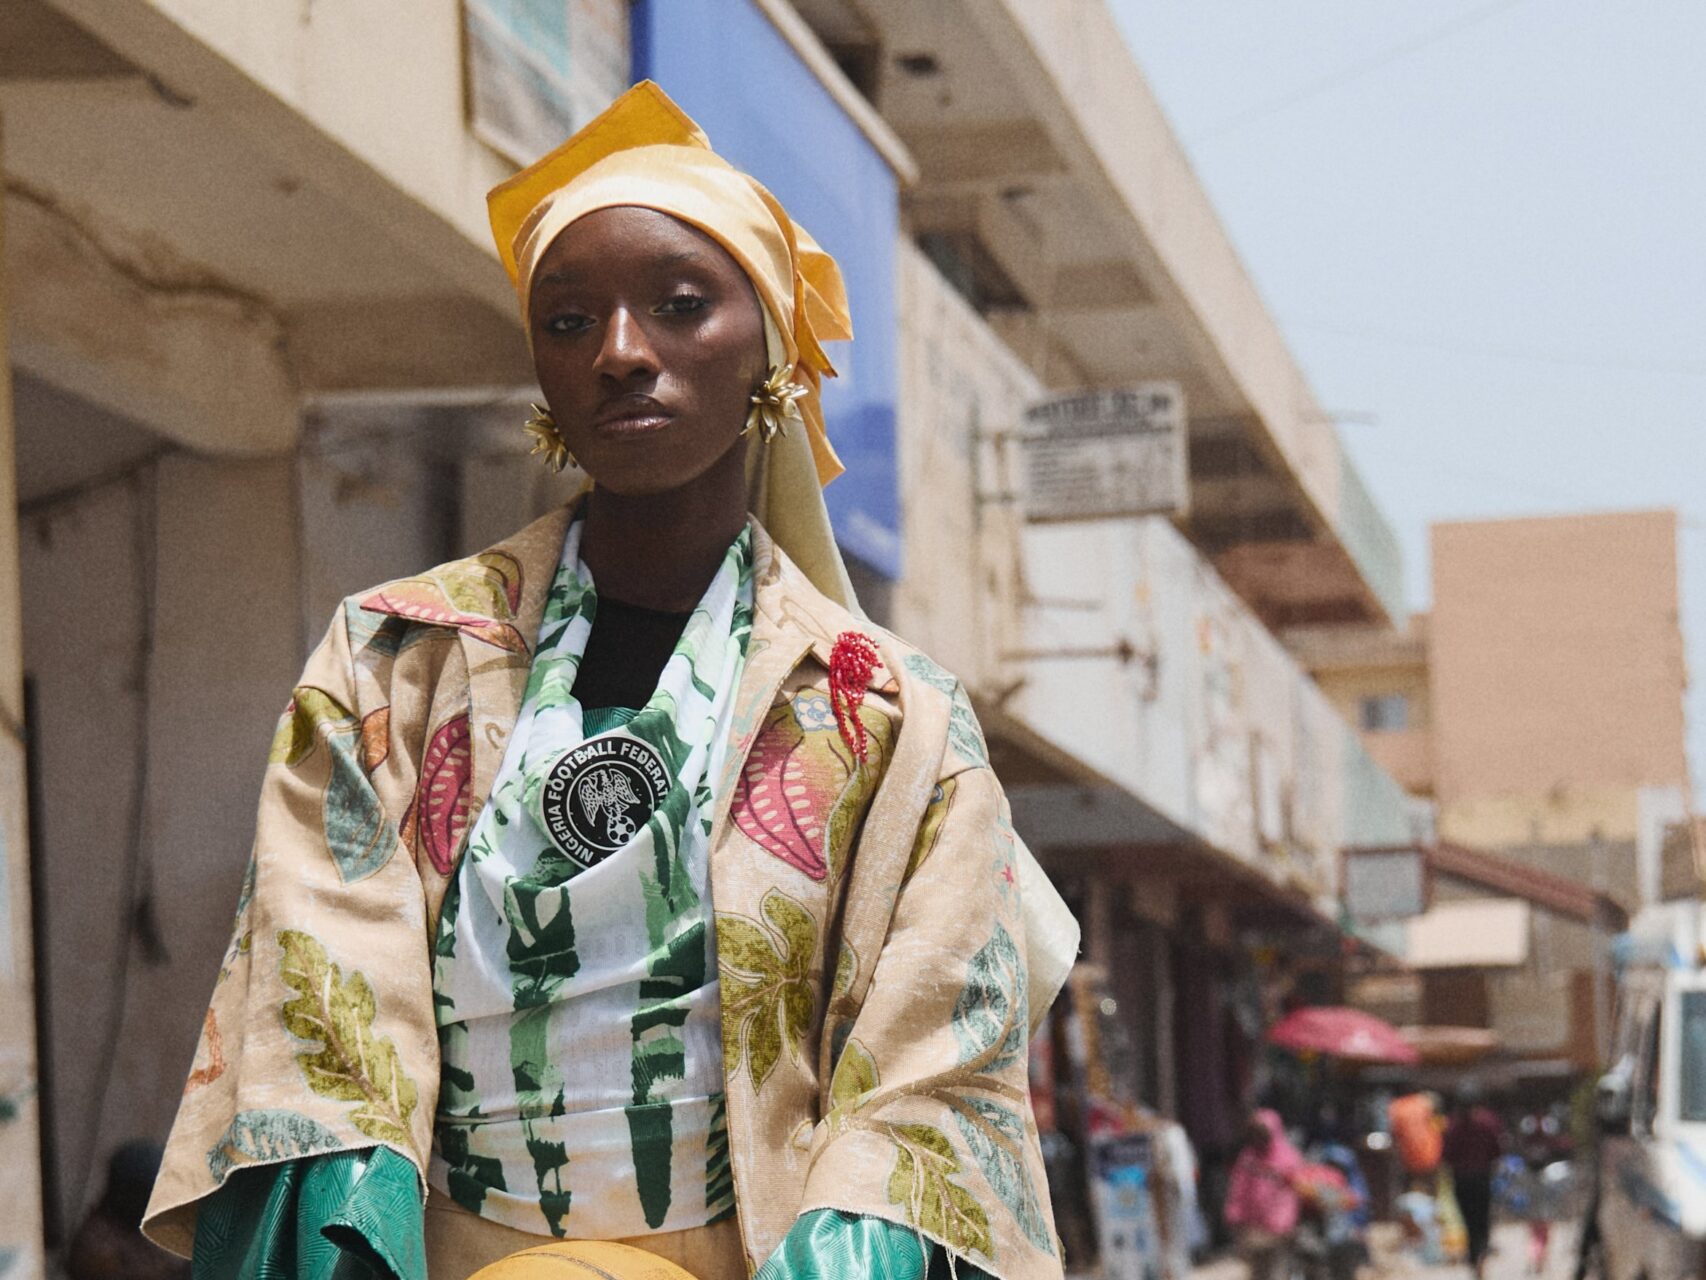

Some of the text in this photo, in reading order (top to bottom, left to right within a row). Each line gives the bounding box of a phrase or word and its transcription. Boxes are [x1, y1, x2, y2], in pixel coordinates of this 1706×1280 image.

[548, 741, 668, 862] NIGERIA FOOTBALL FEDERAT
